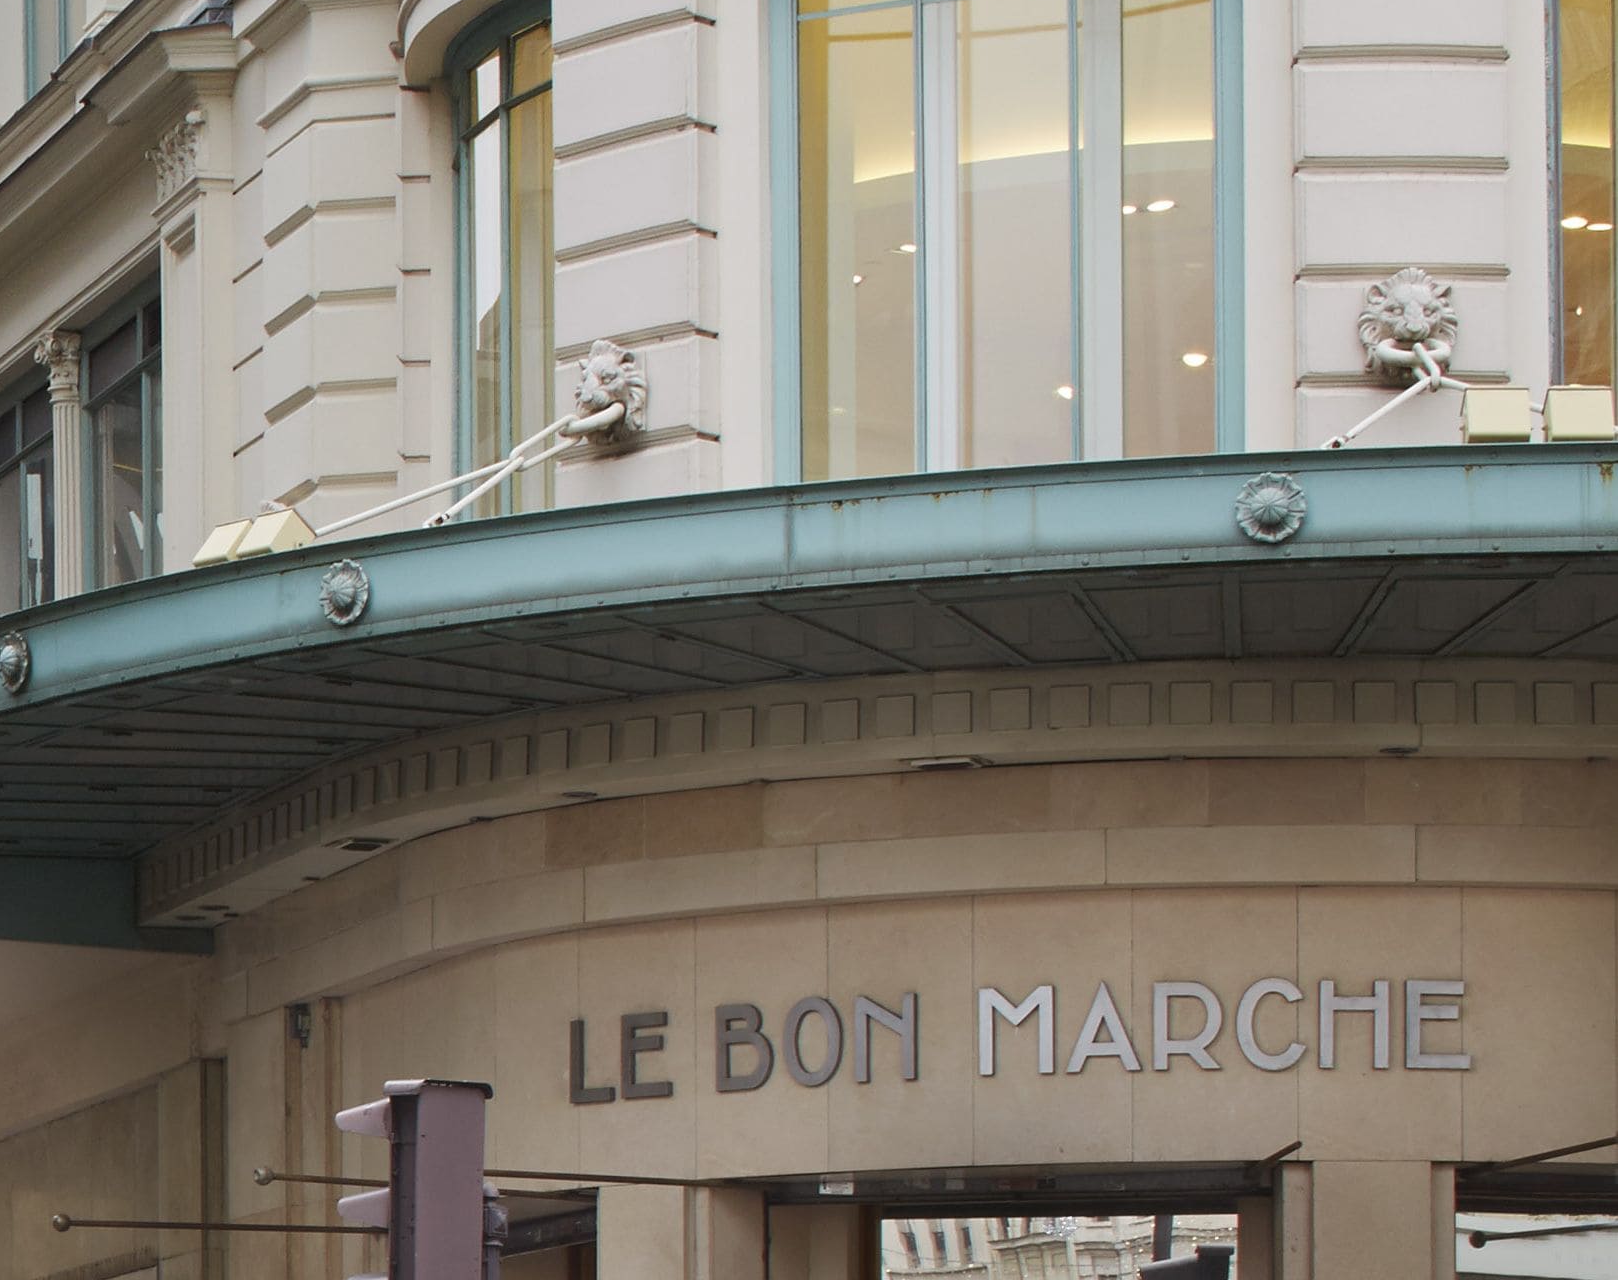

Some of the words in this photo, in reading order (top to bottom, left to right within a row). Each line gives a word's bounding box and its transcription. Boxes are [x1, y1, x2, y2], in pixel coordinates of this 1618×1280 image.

[569, 1011, 673, 1105] LE
[715, 992, 918, 1093] BON
[978, 977, 1472, 1076] MARCHE
